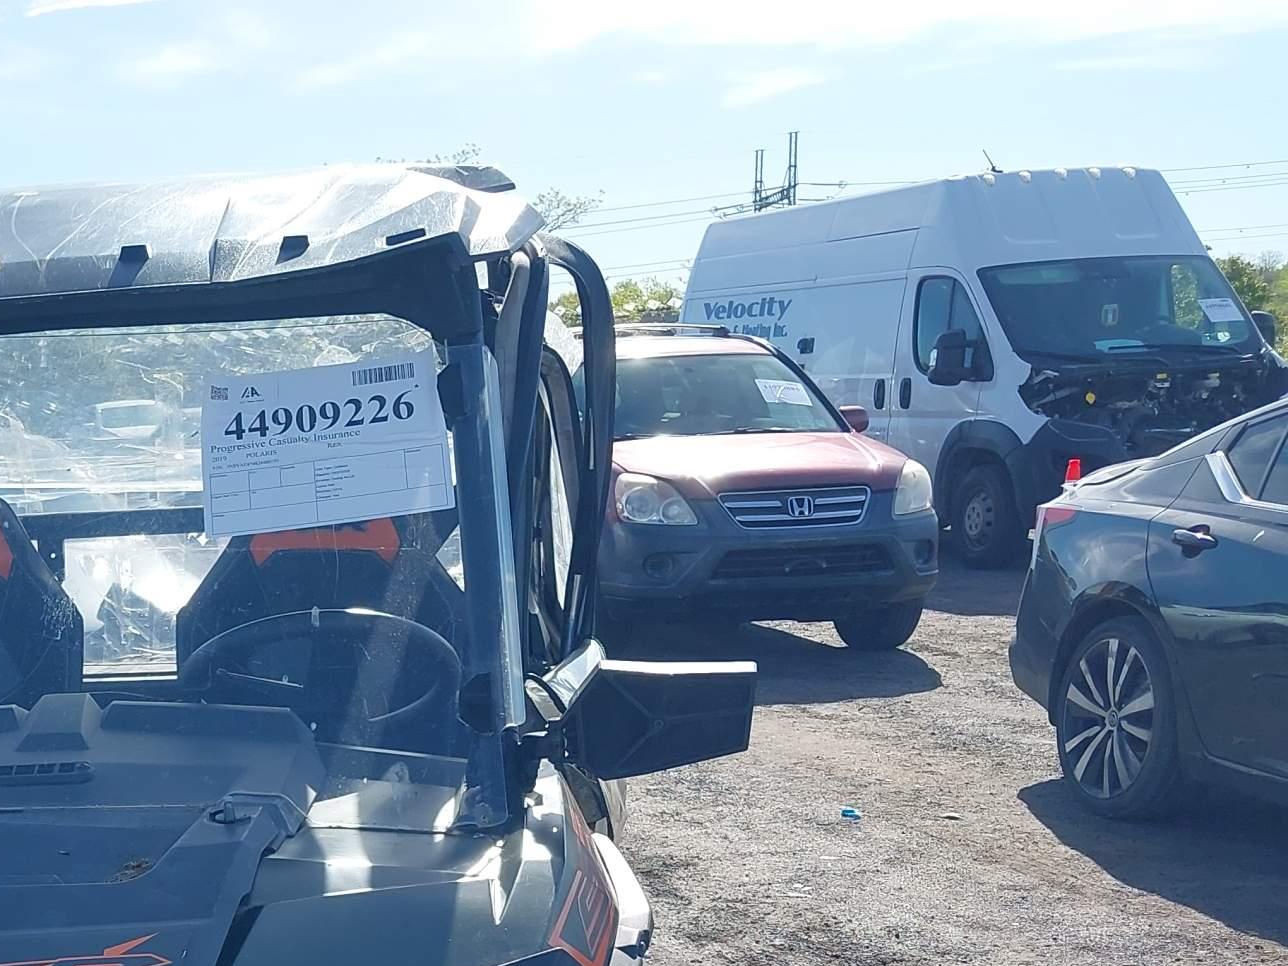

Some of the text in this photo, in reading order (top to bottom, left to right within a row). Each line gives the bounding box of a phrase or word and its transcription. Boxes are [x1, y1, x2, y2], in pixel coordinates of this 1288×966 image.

[703, 296, 793, 321] Velocity
[224, 389, 415, 441] 44909226
[210, 429, 361, 454] Progressive Casualty Insurance
[246, 449, 278, 459] POLARIS
